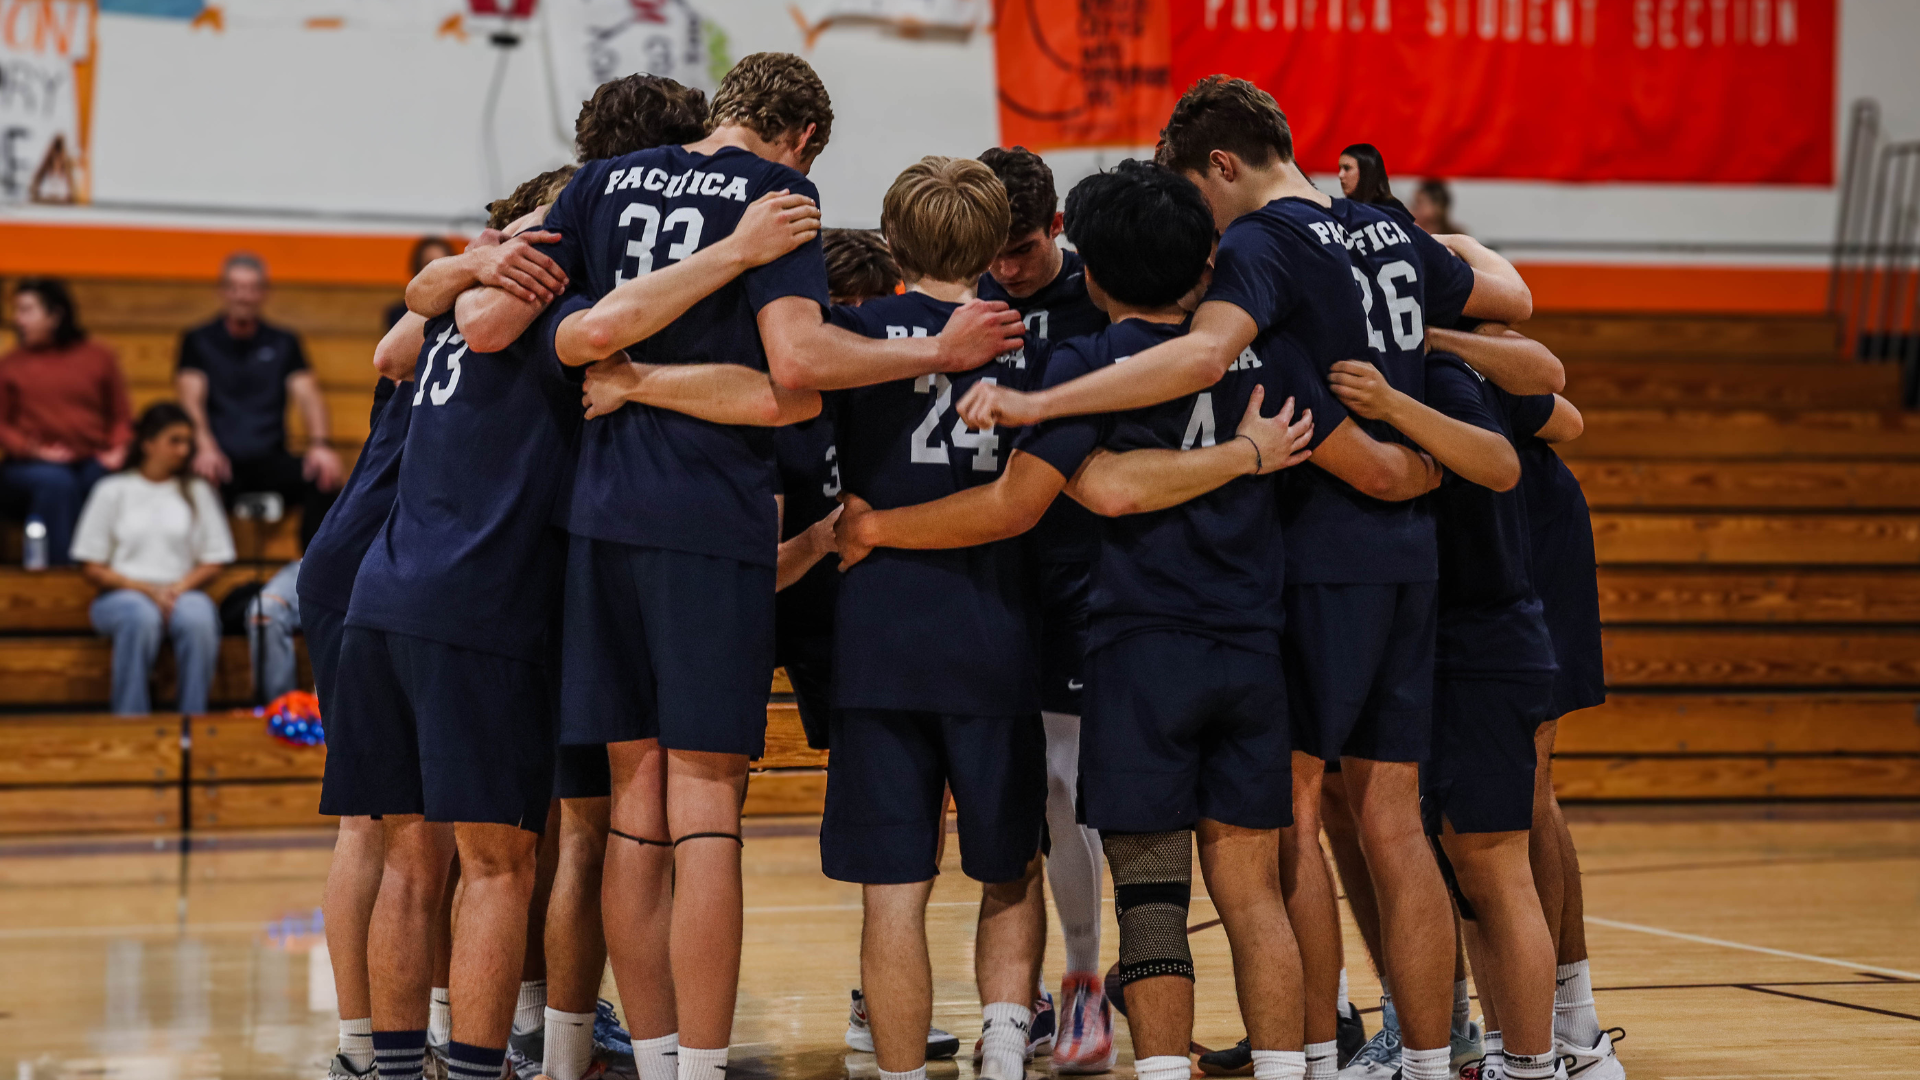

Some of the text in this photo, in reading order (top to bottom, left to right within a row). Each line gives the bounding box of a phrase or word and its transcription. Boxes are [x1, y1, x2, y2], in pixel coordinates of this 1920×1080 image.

[1427, 0, 1597, 47] STUDENT
[1634, 0, 1799, 49] SECTION
[615, 203, 704, 288] 33
[1308, 221, 1411, 256] PACFICA
[412, 323, 469, 406] 13
[911, 372, 999, 472] 24
